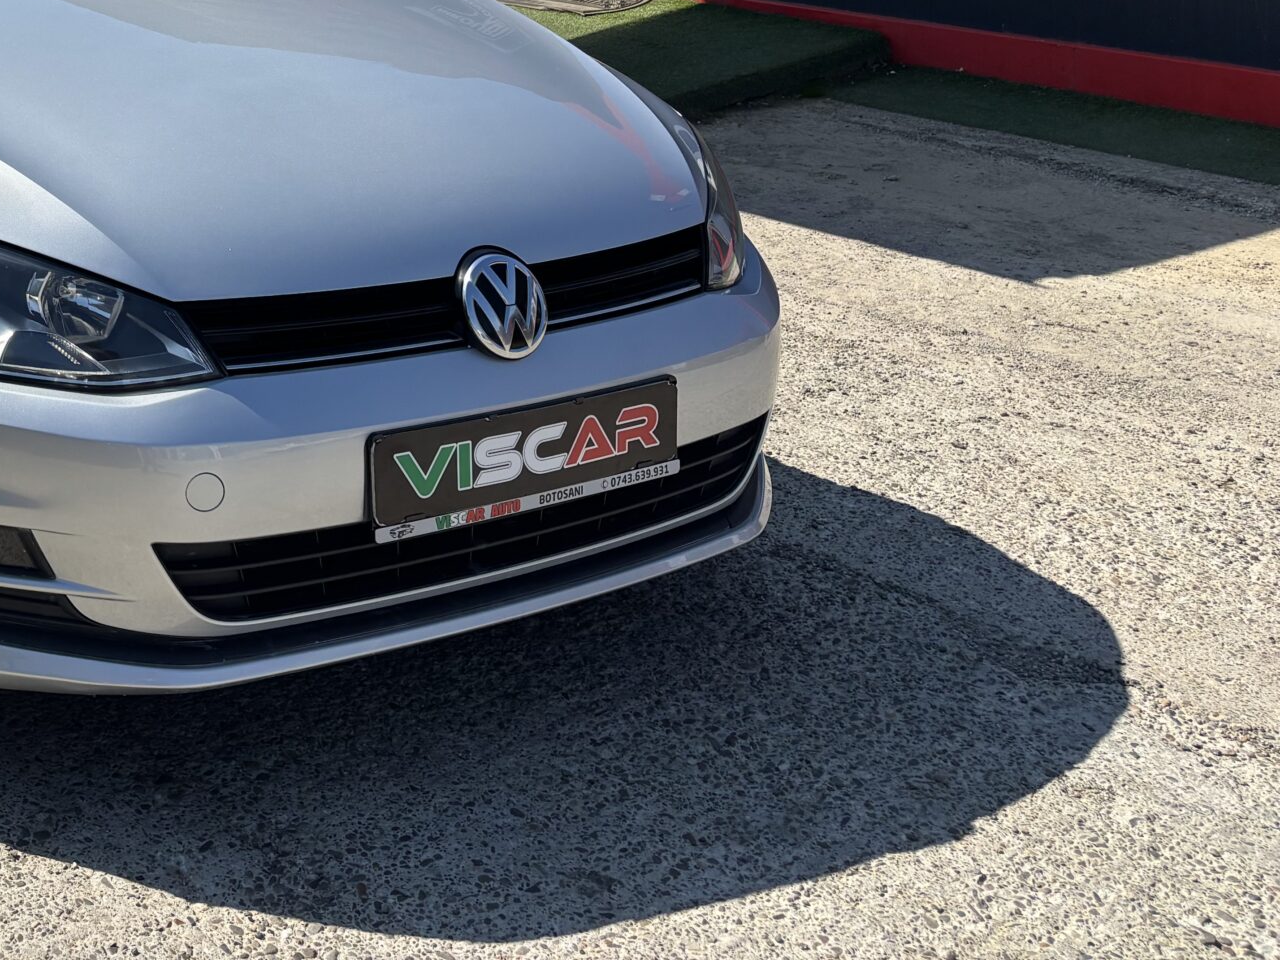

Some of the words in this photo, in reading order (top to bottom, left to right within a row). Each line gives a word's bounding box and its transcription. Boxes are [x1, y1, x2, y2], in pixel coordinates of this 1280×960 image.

[393, 403, 660, 499] VISCAR
[435, 507, 486, 530] VISCAR
[490, 499, 521, 518] AUTO
[539, 485, 585, 505] BOTOSANI
[610, 464, 670, 488] 0743.639.931
